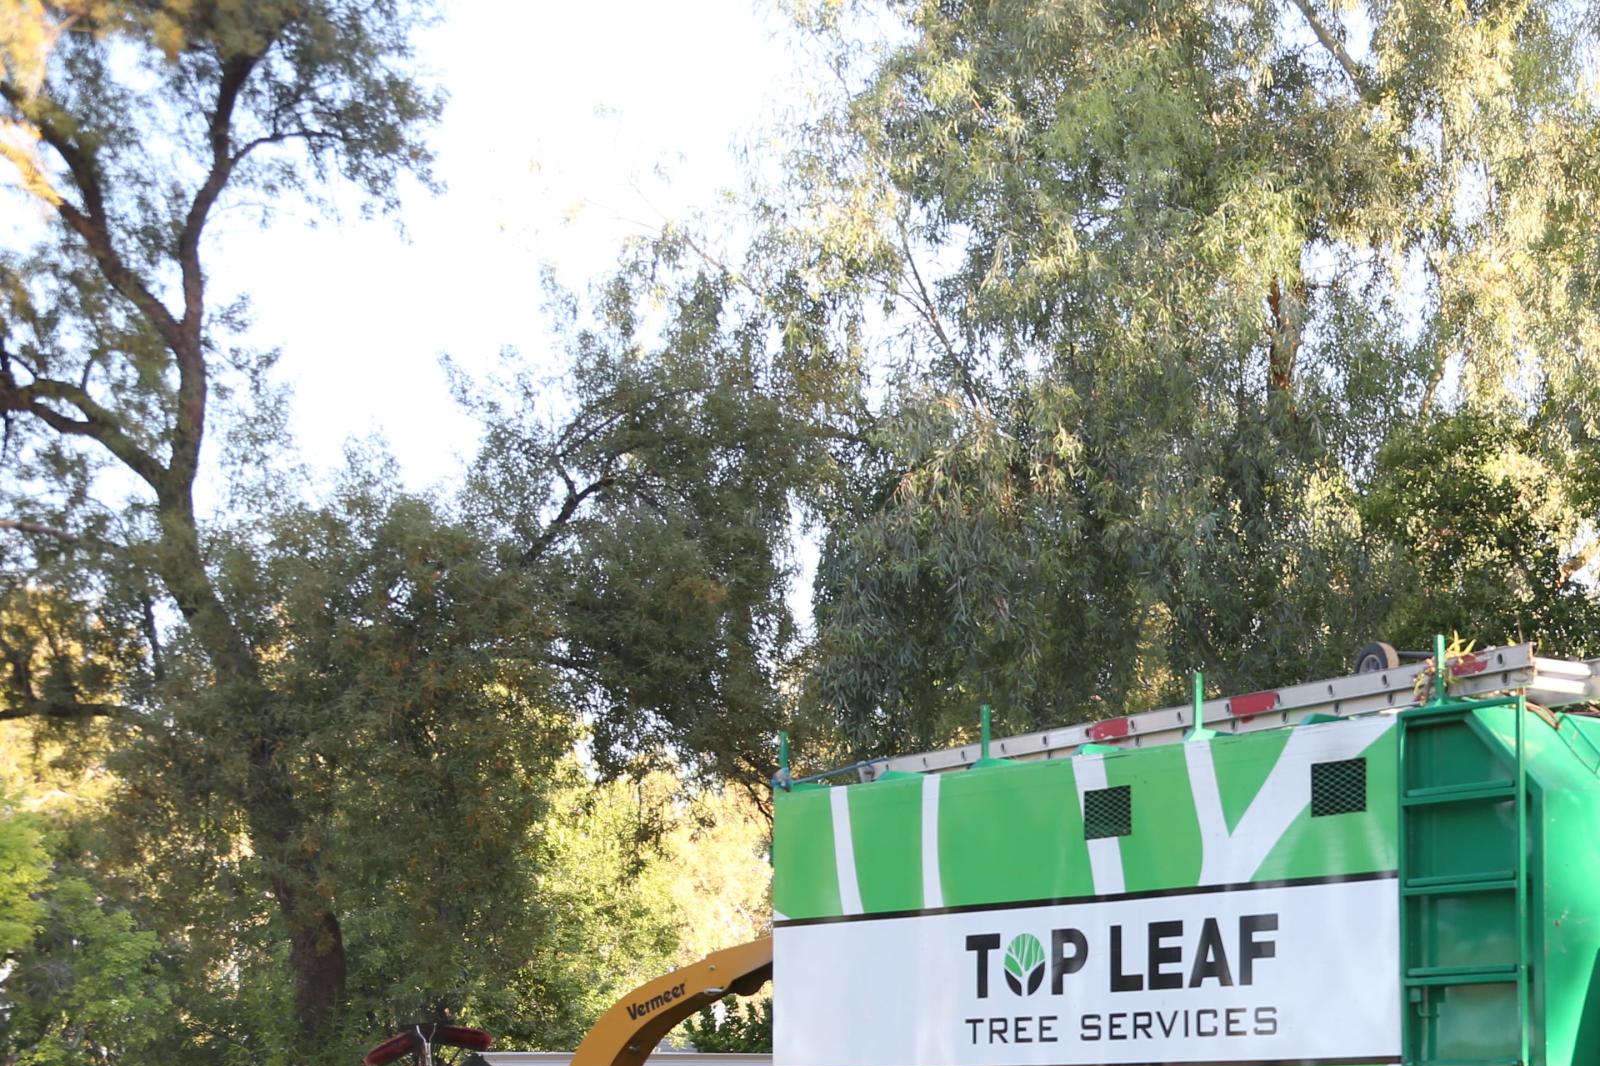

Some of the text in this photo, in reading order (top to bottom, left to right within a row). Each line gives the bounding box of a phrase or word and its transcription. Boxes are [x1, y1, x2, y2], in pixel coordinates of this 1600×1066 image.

[1109, 913, 1279, 993] LEAF
[626, 982, 686, 1021] Vermeer
[965, 1006, 1278, 1044] TREE SERVICES
